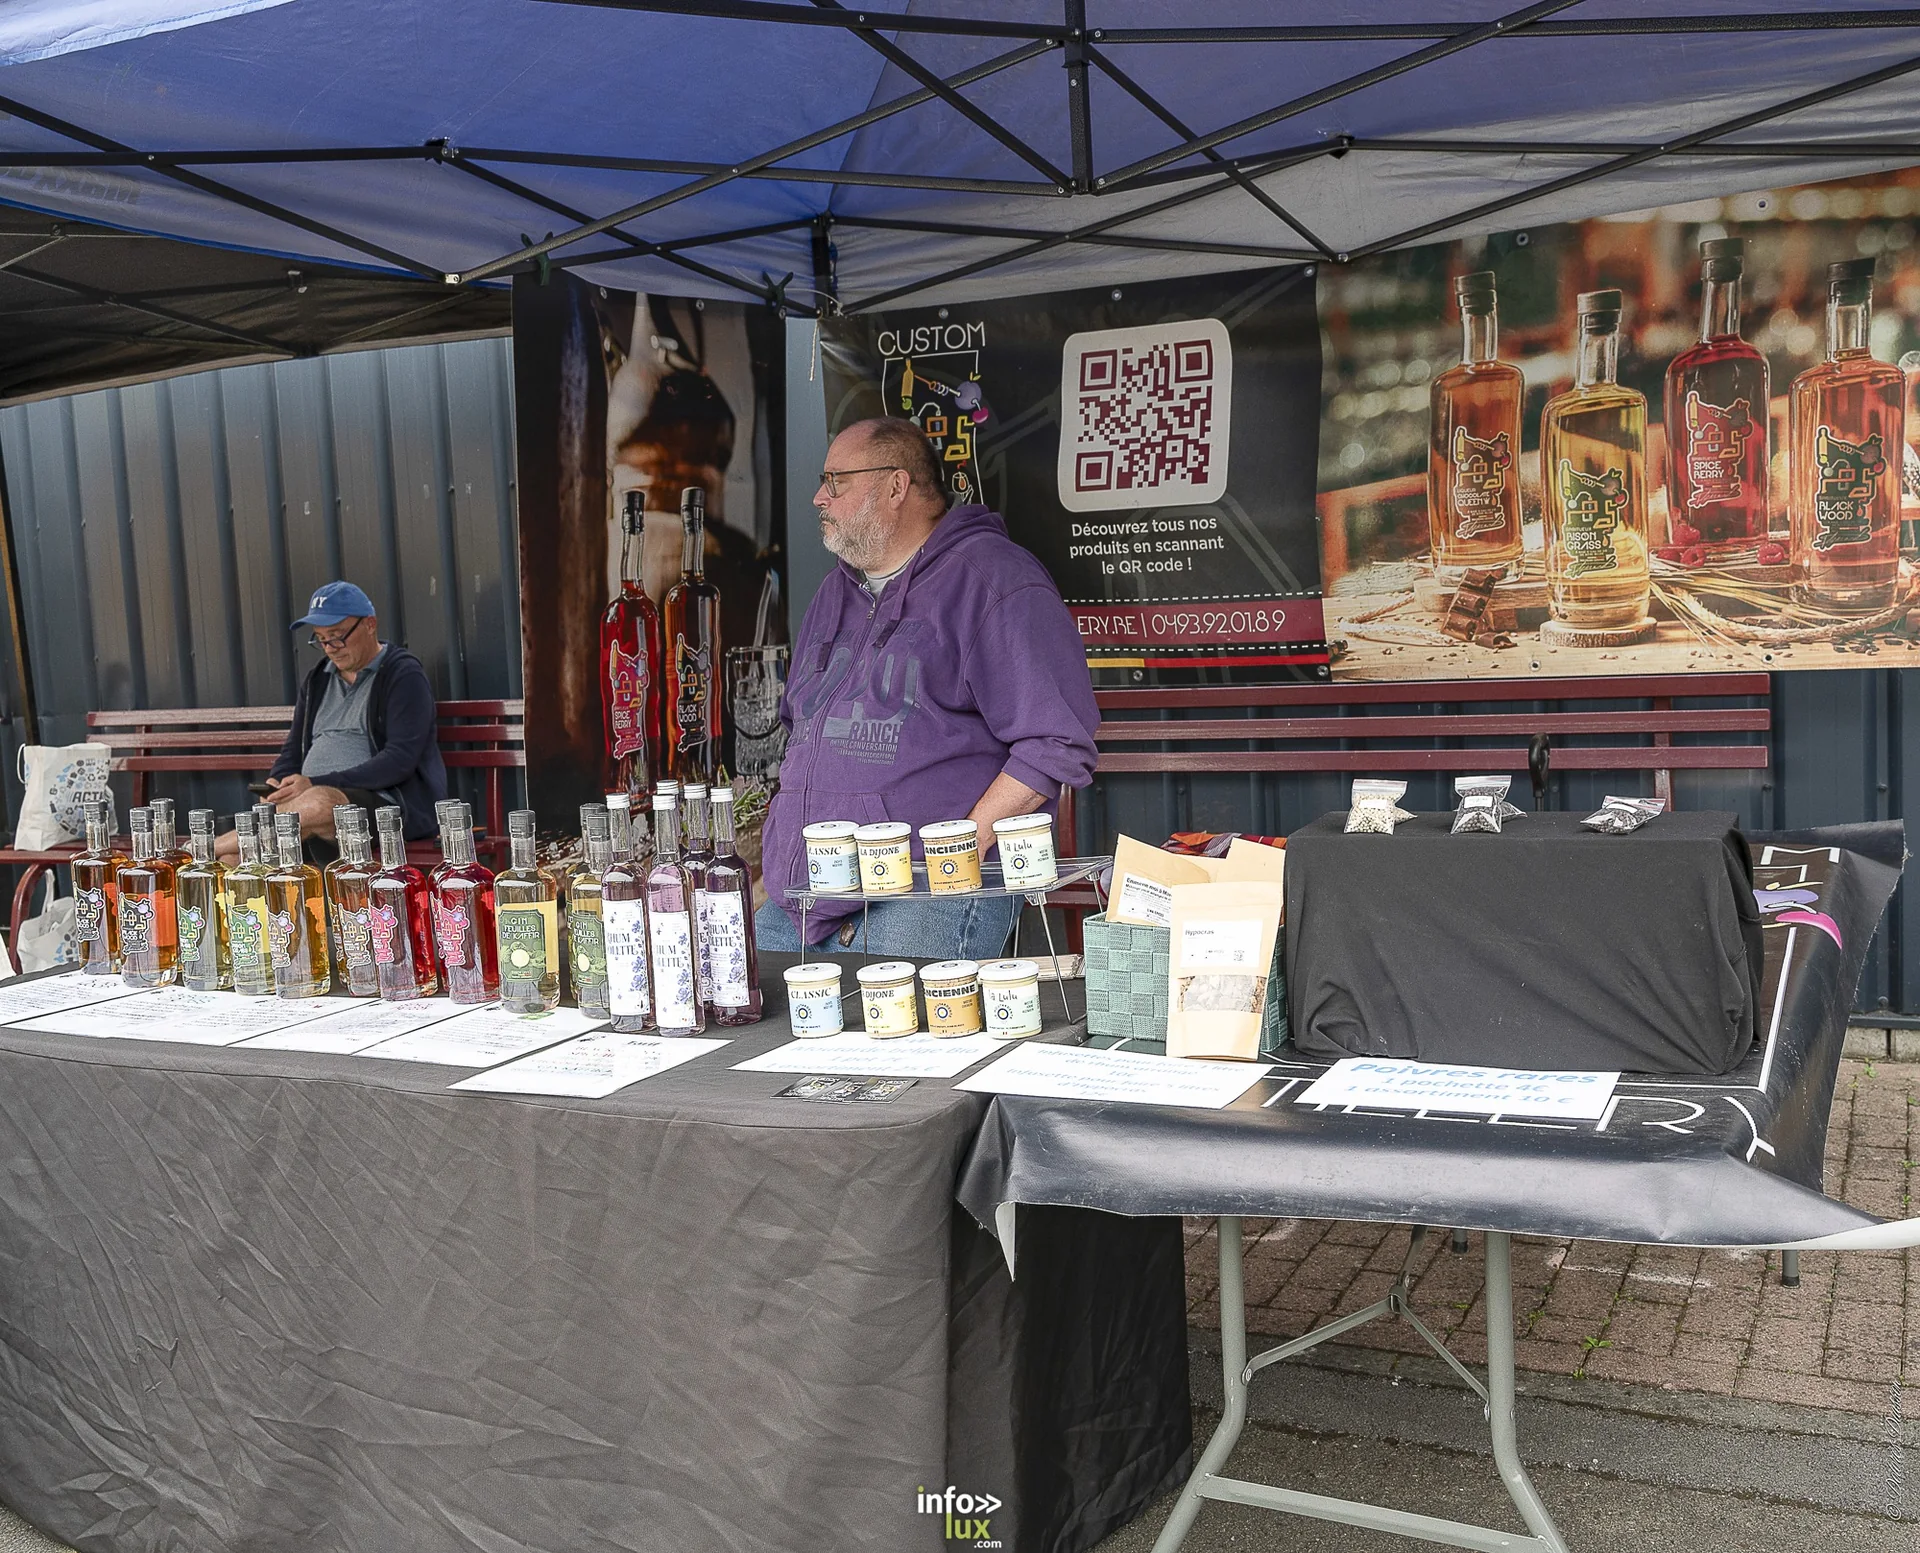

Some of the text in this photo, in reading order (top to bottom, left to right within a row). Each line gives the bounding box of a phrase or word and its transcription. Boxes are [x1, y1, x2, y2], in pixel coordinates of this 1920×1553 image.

[878, 322, 986, 356] CUSTOM
[1693, 460, 1722, 470] SPICE
[1693, 469, 1725, 480] BERRY
[1458, 498, 1484, 507] QUEEN
[1818, 500, 1854, 511] BLACK
[1818, 510, 1854, 520] WOOD
[1070, 517, 1217, 538] Découvrez tous nos
[1566, 532, 1598, 541] BISON
[1069, 535, 1225, 559] produits en scannant
[1566, 540, 1602, 550] GRASS
[1101, 559, 1114, 574] le
[1118, 558, 1142, 575] QR
[1146, 557, 1184, 573] code
[310, 596, 328, 609] NY
[1151, 609, 1287, 635] 0493.92.01.89
[614, 710, 630, 720] SPICE
[614, 719, 632, 729] BERRY
[1013, 839, 1033, 852] Lulu
[504, 924, 536, 932] FEUILLES
[575, 921, 588, 930] GIN
[512, 931, 540, 940] KAFFIR
[998, 990, 1018, 1002] Lulu
[1497, 1072, 1599, 1084] rares
[1400, 1078, 1510, 1091] pochette
[1364, 1087, 1513, 1100] assortiment
[1518, 1095, 1551, 1103] 10
